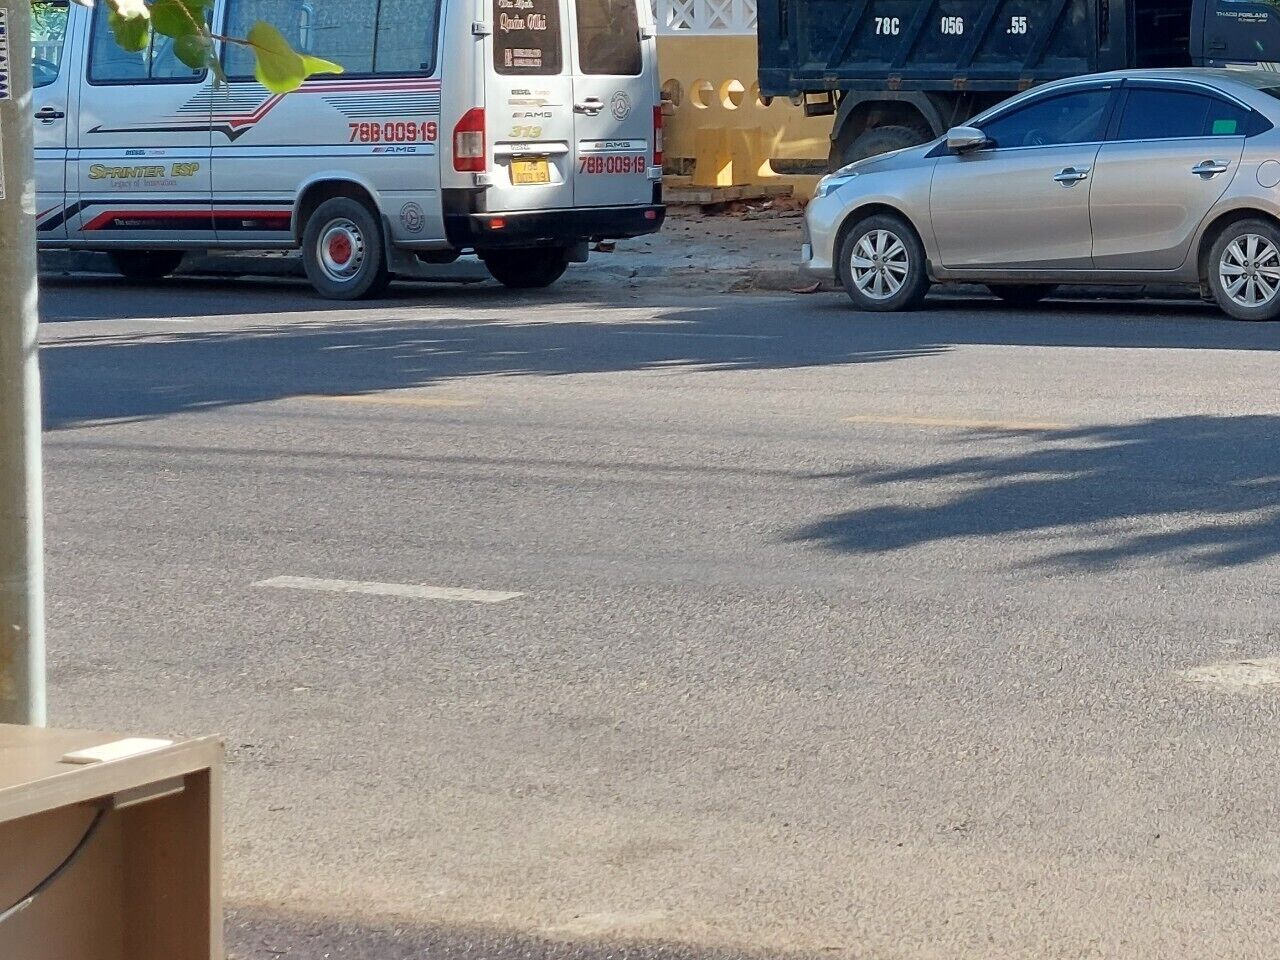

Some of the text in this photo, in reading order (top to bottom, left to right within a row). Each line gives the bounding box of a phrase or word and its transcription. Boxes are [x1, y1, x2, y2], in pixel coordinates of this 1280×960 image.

[874, 17, 900, 35] 78C
[941, 16, 964, 35] 056
[508, 125, 542, 138] 313
[88, 162, 200, 180] SPRINTER ESP
